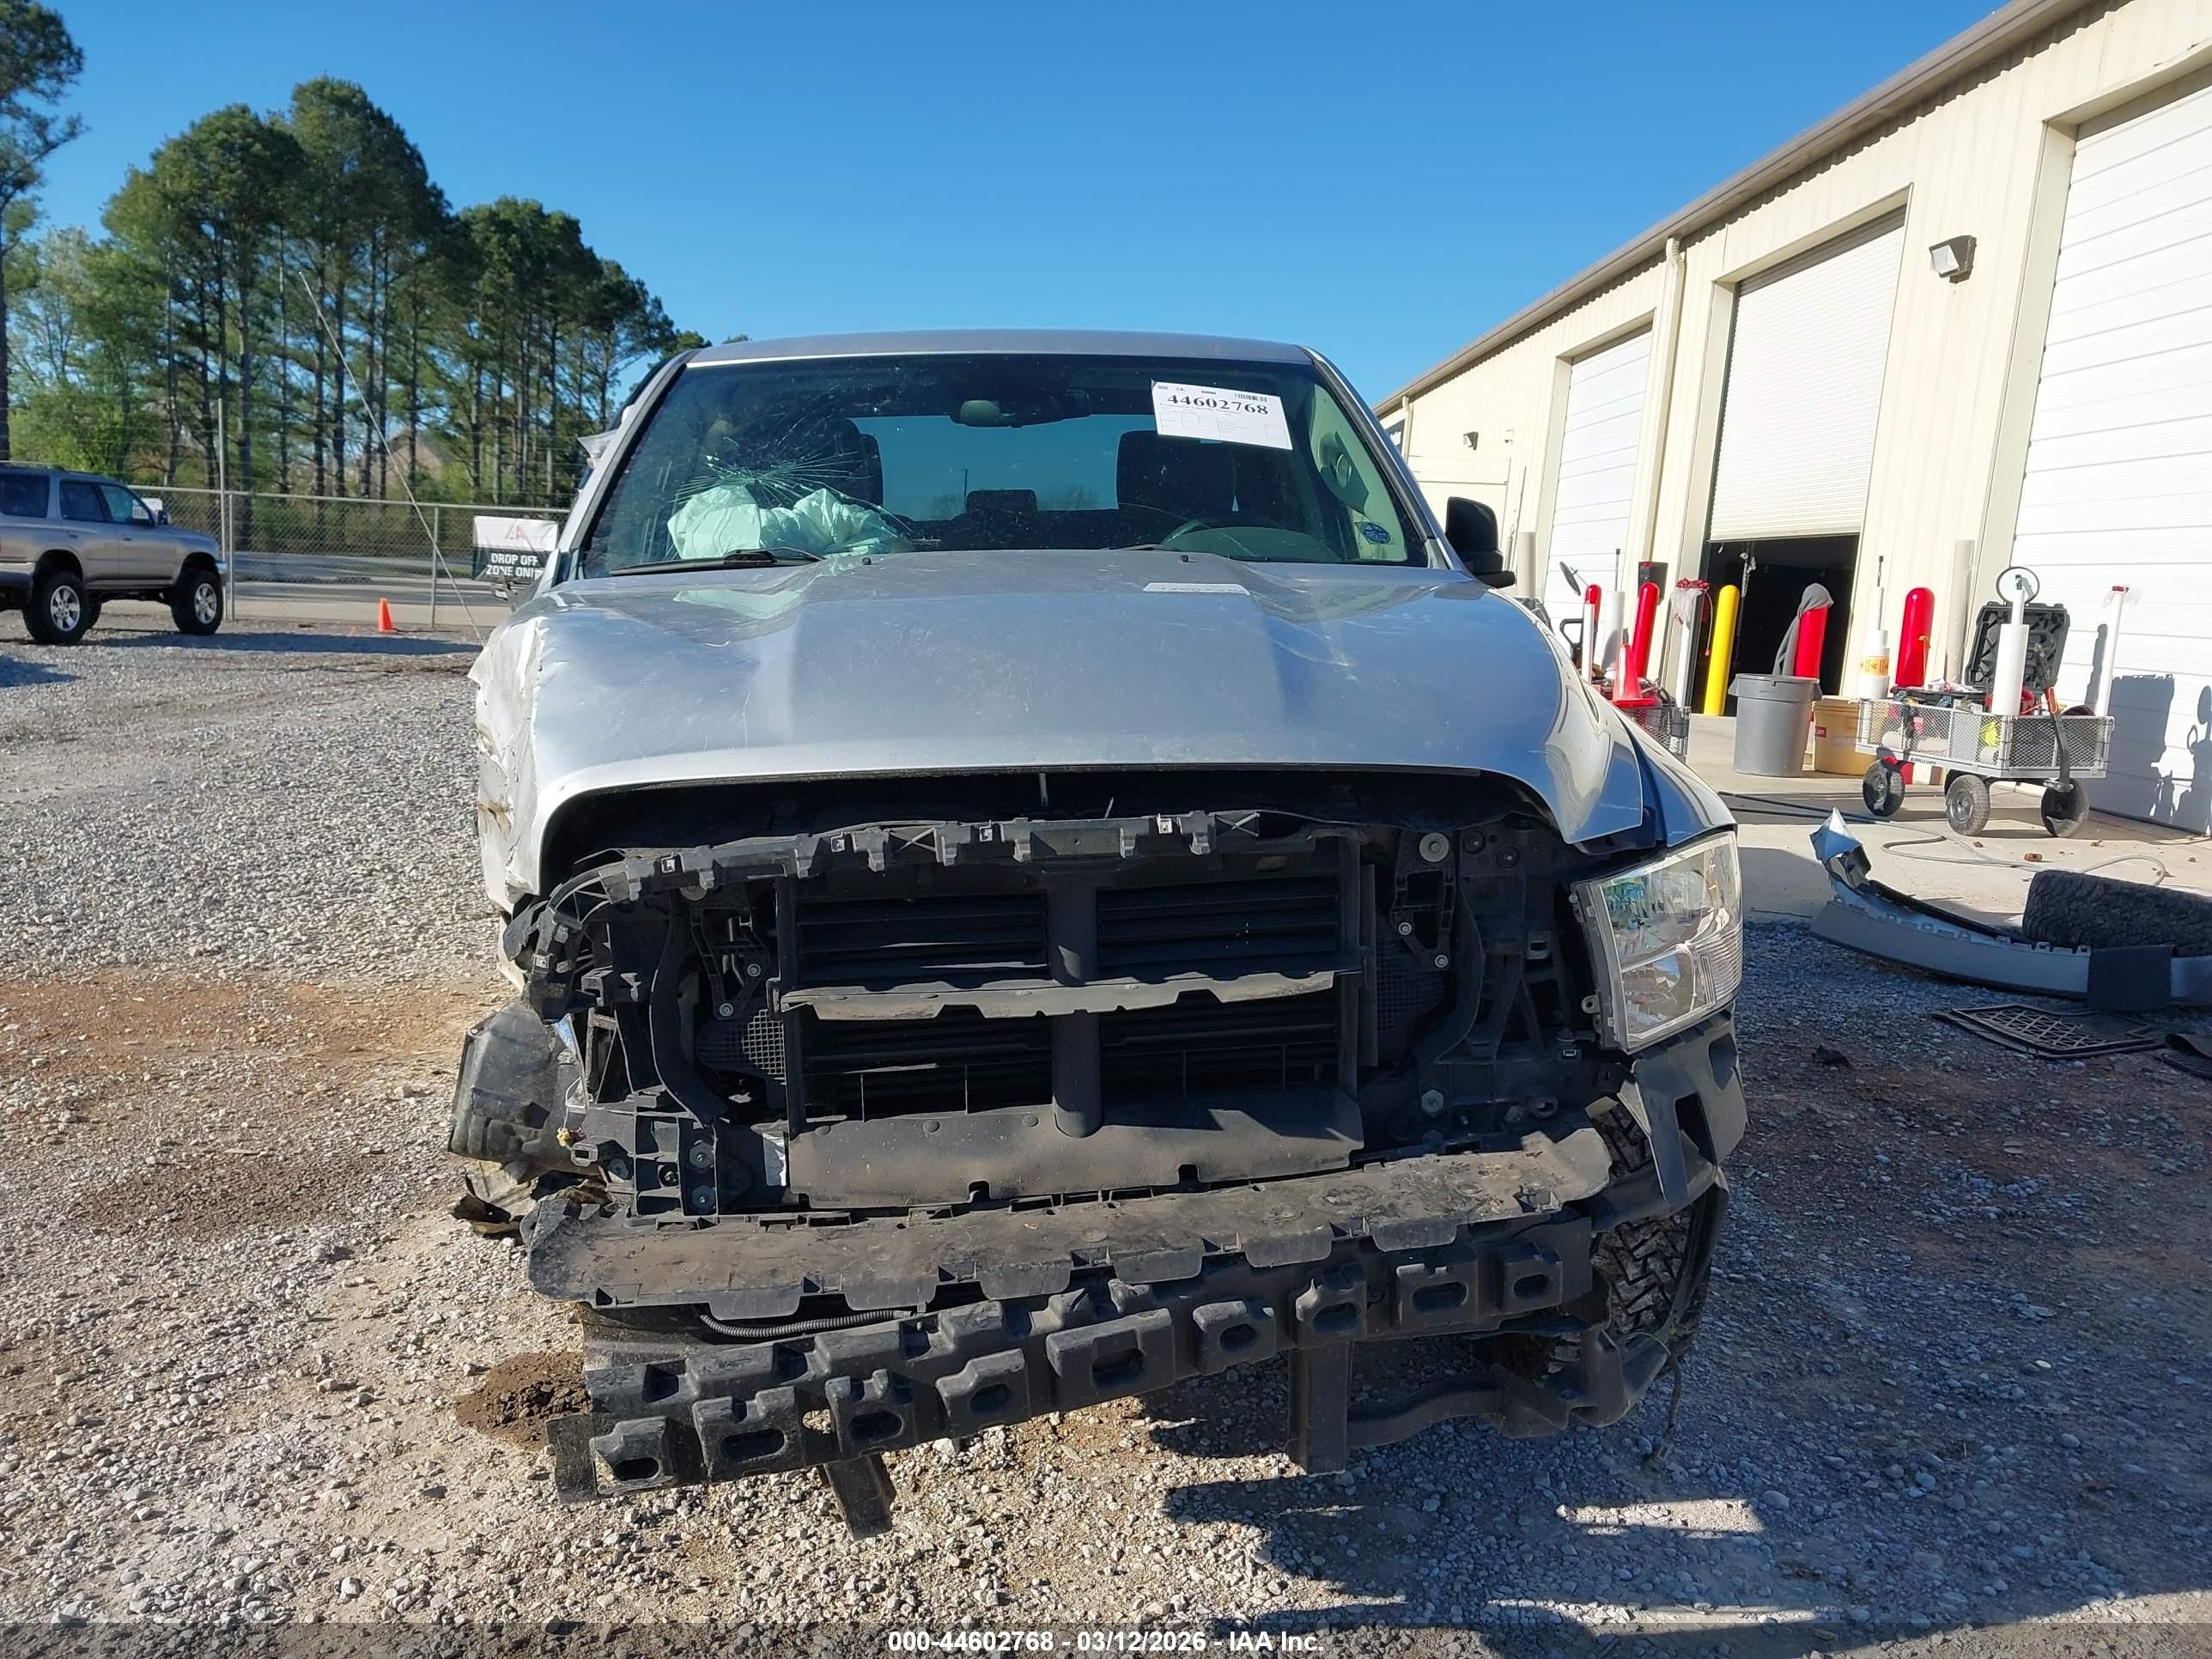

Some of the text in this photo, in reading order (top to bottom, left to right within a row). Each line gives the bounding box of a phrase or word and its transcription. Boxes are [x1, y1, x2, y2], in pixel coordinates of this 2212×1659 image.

[1166, 394, 1269, 416] 44602768
[490, 552, 538, 567] DROP OFF
[485, 564, 514, 576] ZONE
